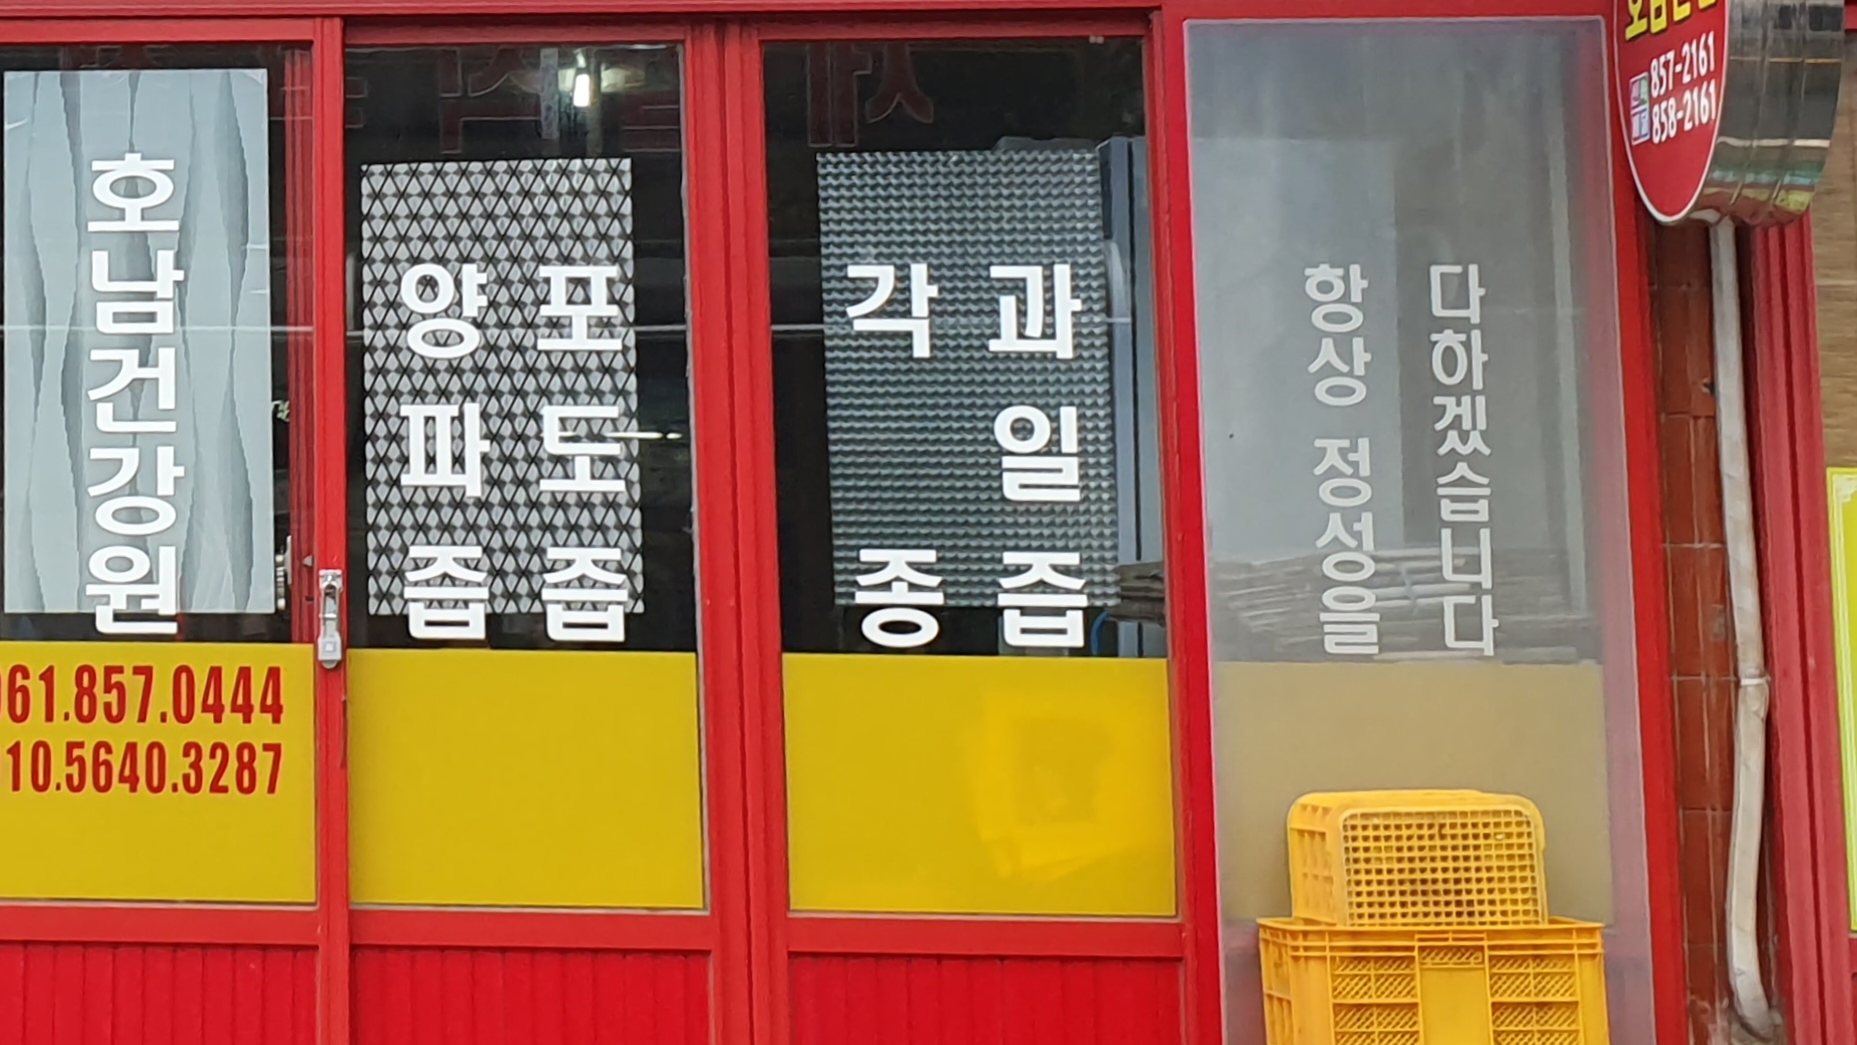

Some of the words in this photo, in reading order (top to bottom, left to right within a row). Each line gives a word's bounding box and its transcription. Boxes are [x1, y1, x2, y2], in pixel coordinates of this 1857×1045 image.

[1650, 31, 1715, 99] 857-2161
[1652, 78, 1717, 145] 858-2161
[86, 152, 185, 636] 호남건강원
[399, 262, 490, 643] 양파즙
[537, 264, 631, 644] 포도즙
[987, 263, 1089, 650] 과일즙
[1303, 263, 1372, 408] 항상
[1428, 263, 1500, 657] 다하겠습니다
[1312, 437, 1382, 656] 정성을
